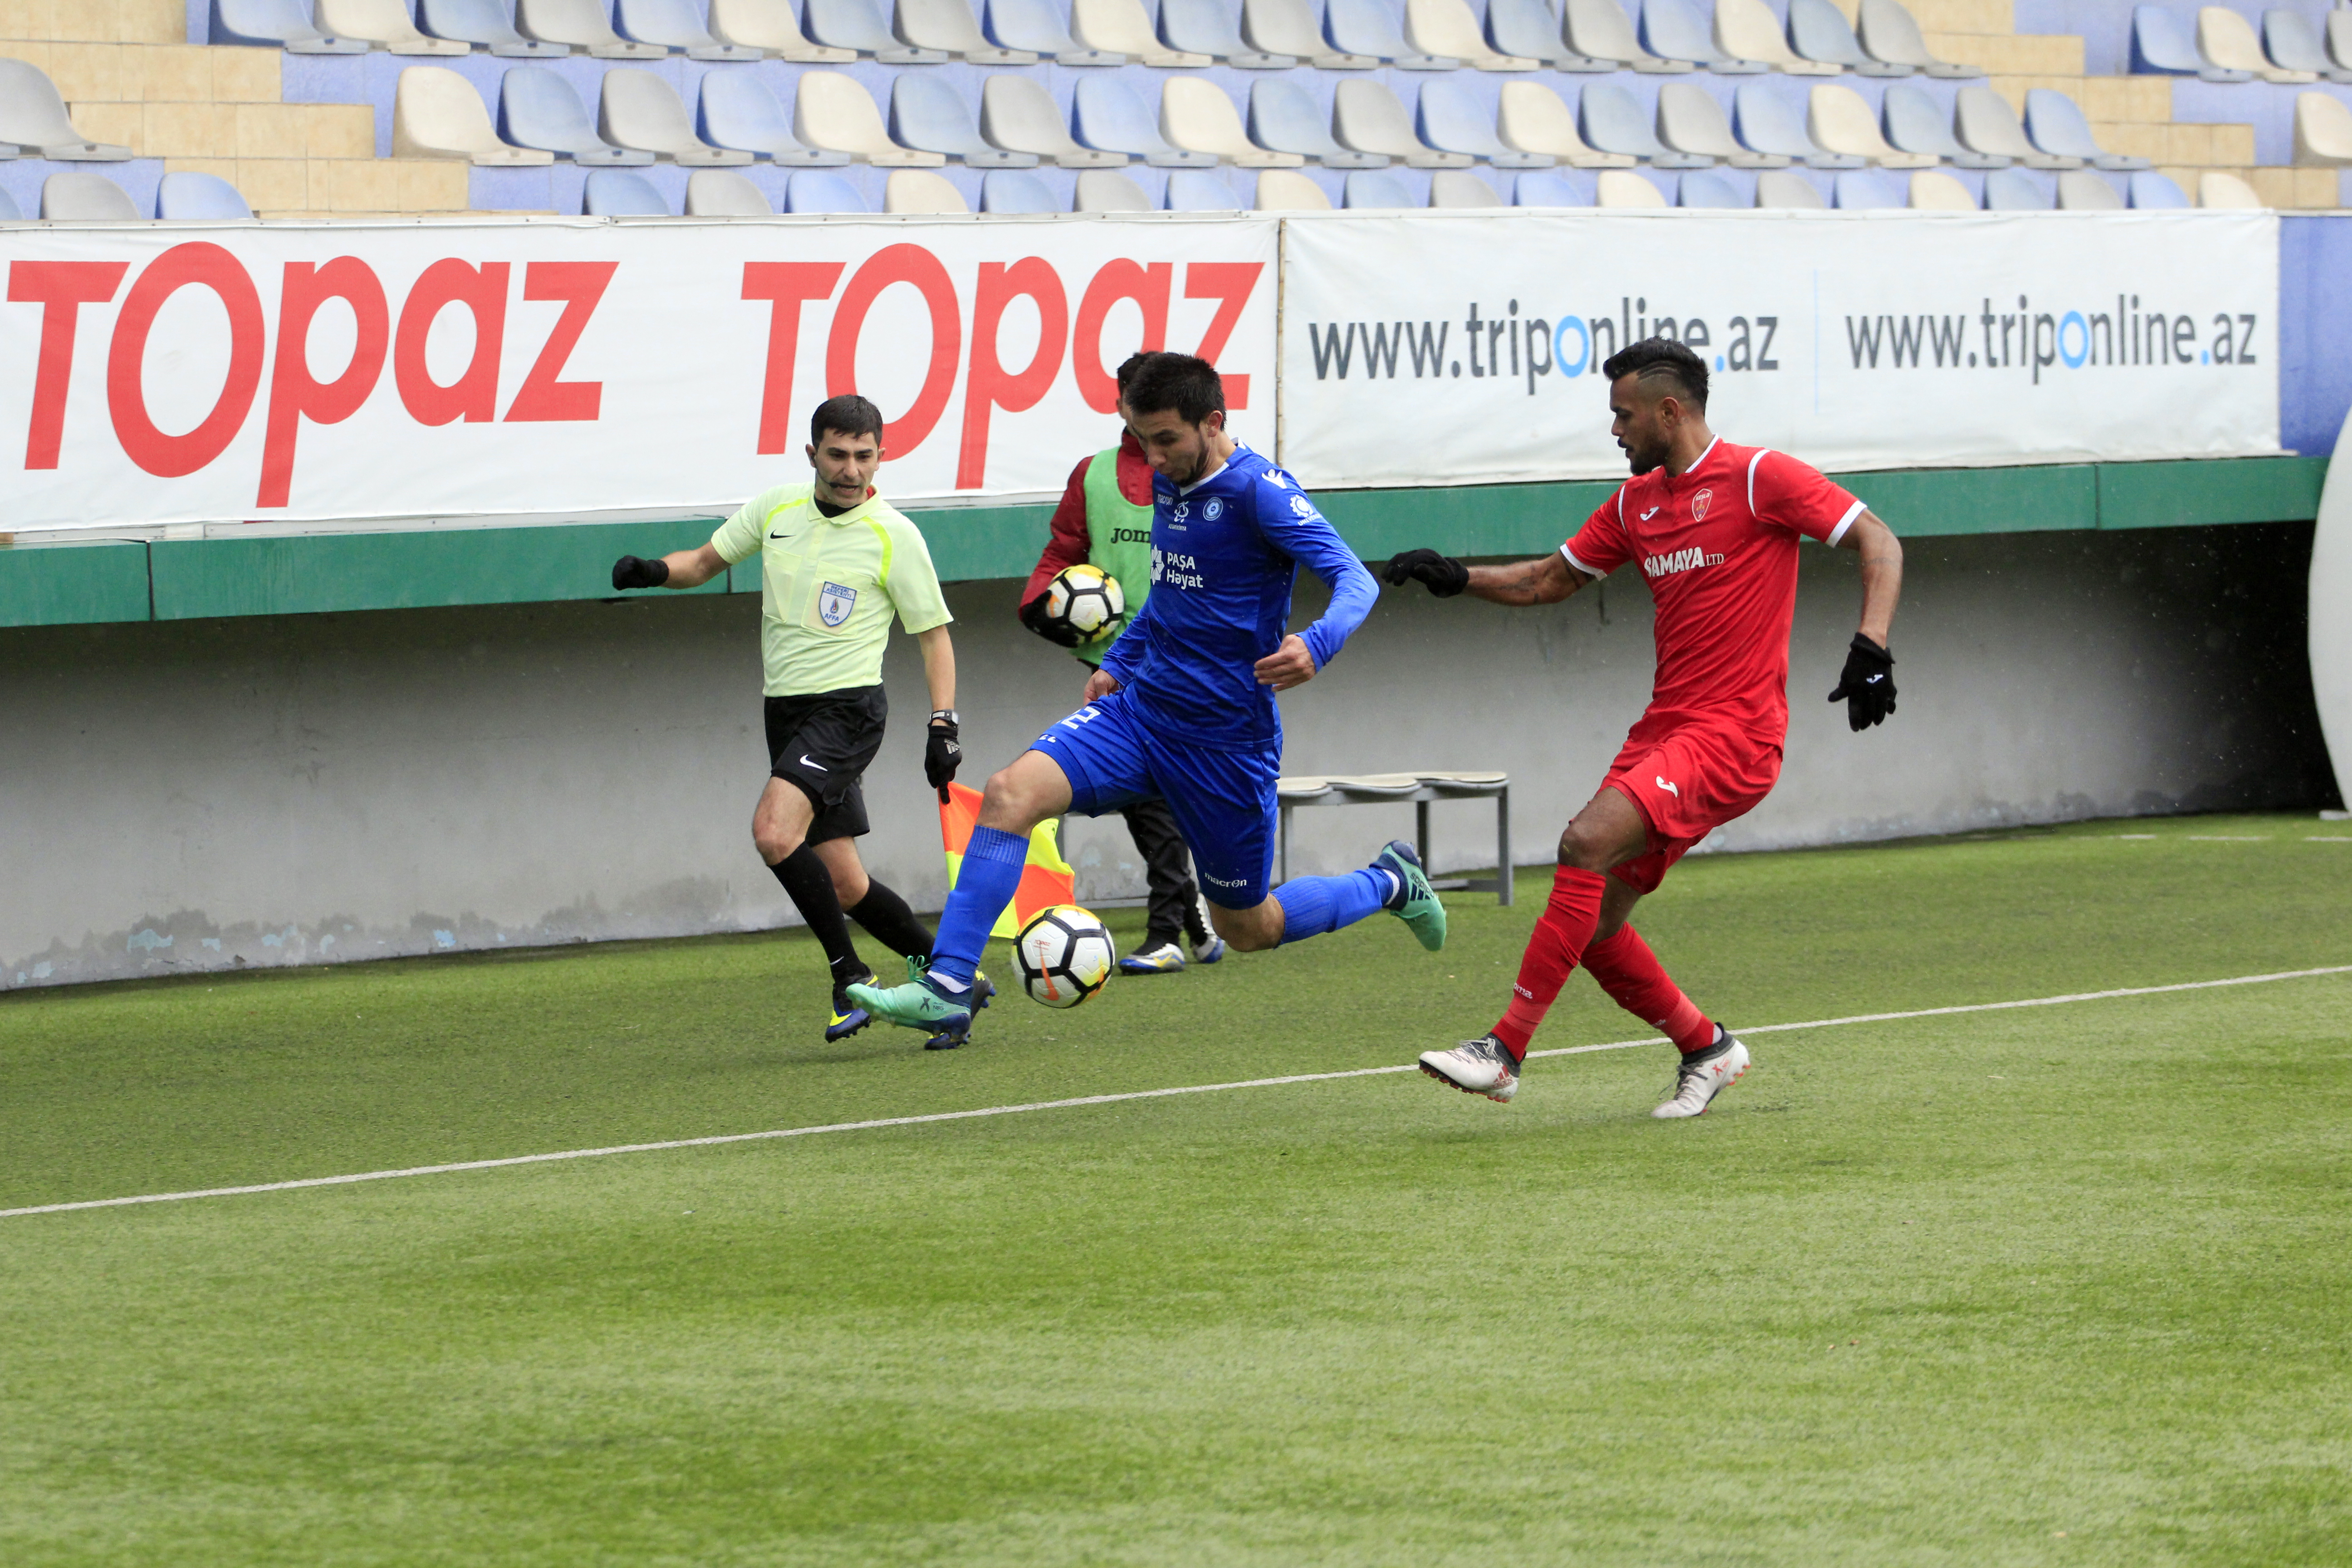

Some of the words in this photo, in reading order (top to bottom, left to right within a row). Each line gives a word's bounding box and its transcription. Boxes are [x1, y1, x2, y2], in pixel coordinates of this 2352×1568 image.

[1845, 294, 2256, 385] www.triponline.az
[1167, 552, 1196, 571] PAŞA
[1644, 547, 1705, 577] SAMAYA
[1706, 553, 1725, 566] LTD
[1166, 569, 1203, 590] Həyat
[824, 613, 839, 622] AFFA
[1205, 872, 1247, 887] macron
[1514, 983, 1533, 999] oma
